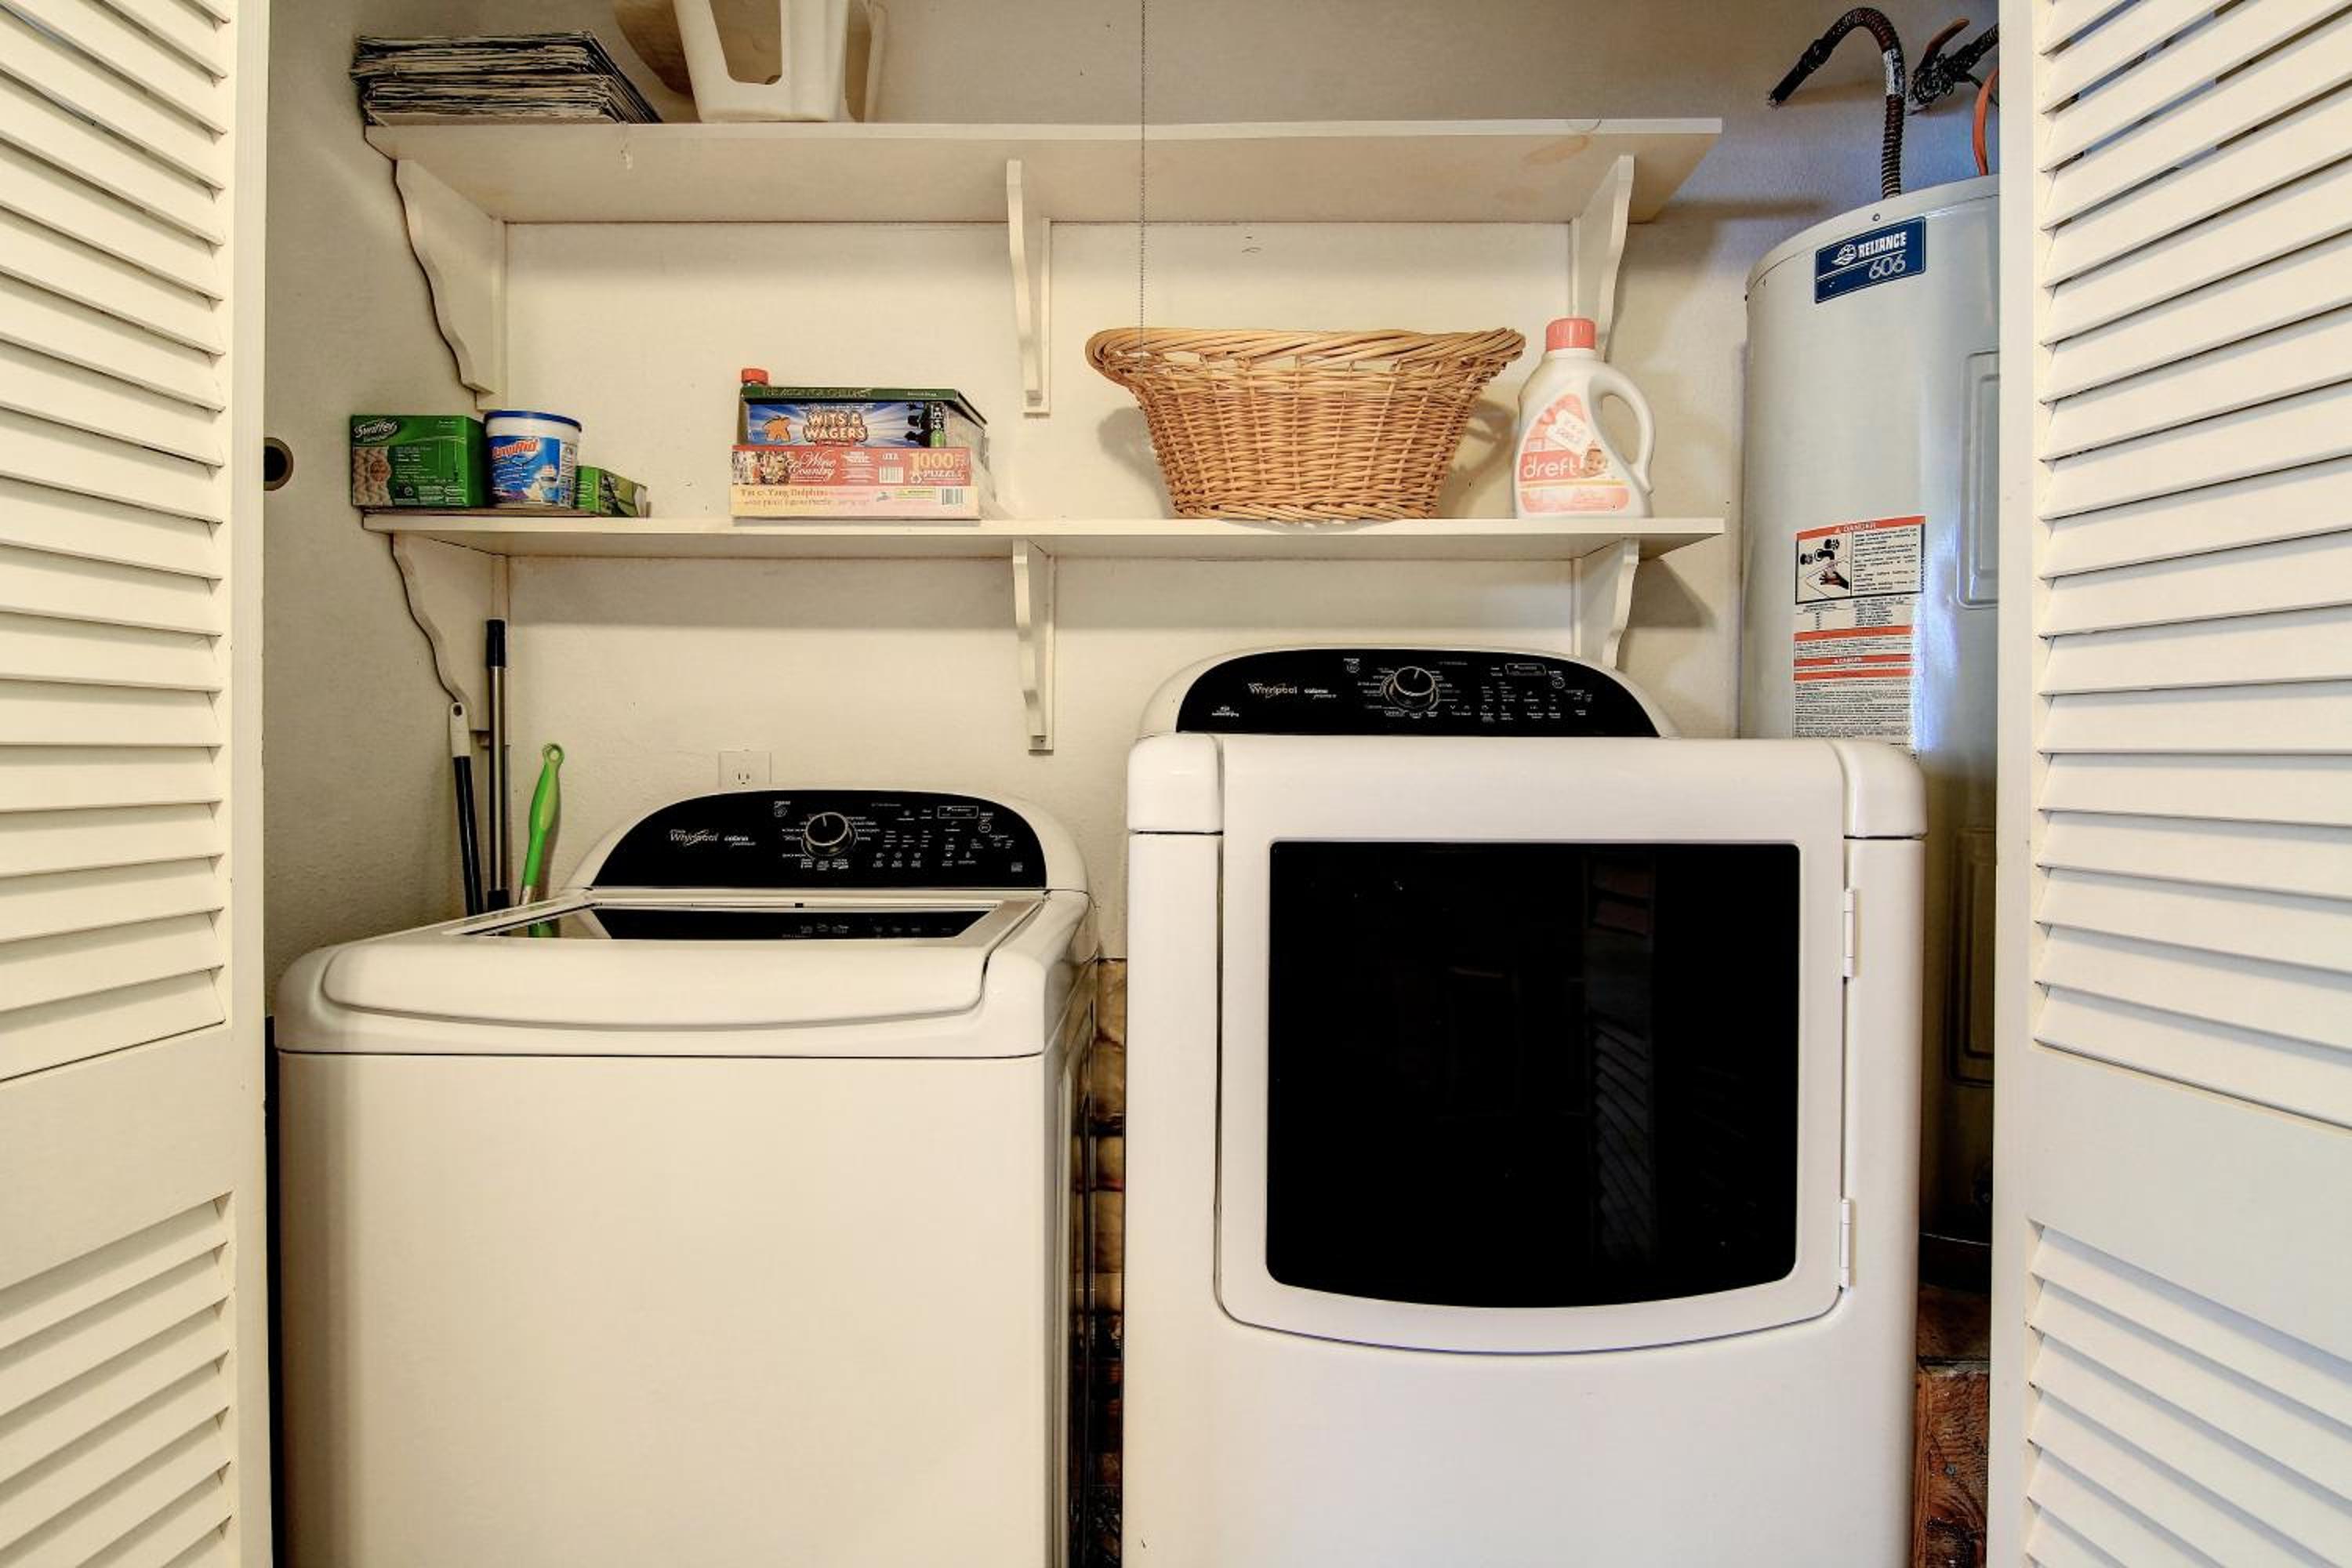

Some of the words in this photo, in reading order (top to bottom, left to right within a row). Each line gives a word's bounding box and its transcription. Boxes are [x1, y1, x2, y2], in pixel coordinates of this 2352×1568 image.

[1858, 231, 1907, 259] RELIANCE
[1869, 253, 1906, 279] 606
[808, 412, 848, 425] WITS
[354, 420, 398, 438] Swiffer
[804, 426, 866, 439] WAGERS
[909, 451, 955, 475] 1000
[1523, 455, 1579, 477] dreft
[1247, 683, 1298, 699] Whirlpool
[670, 829, 720, 847] Whirlpool
